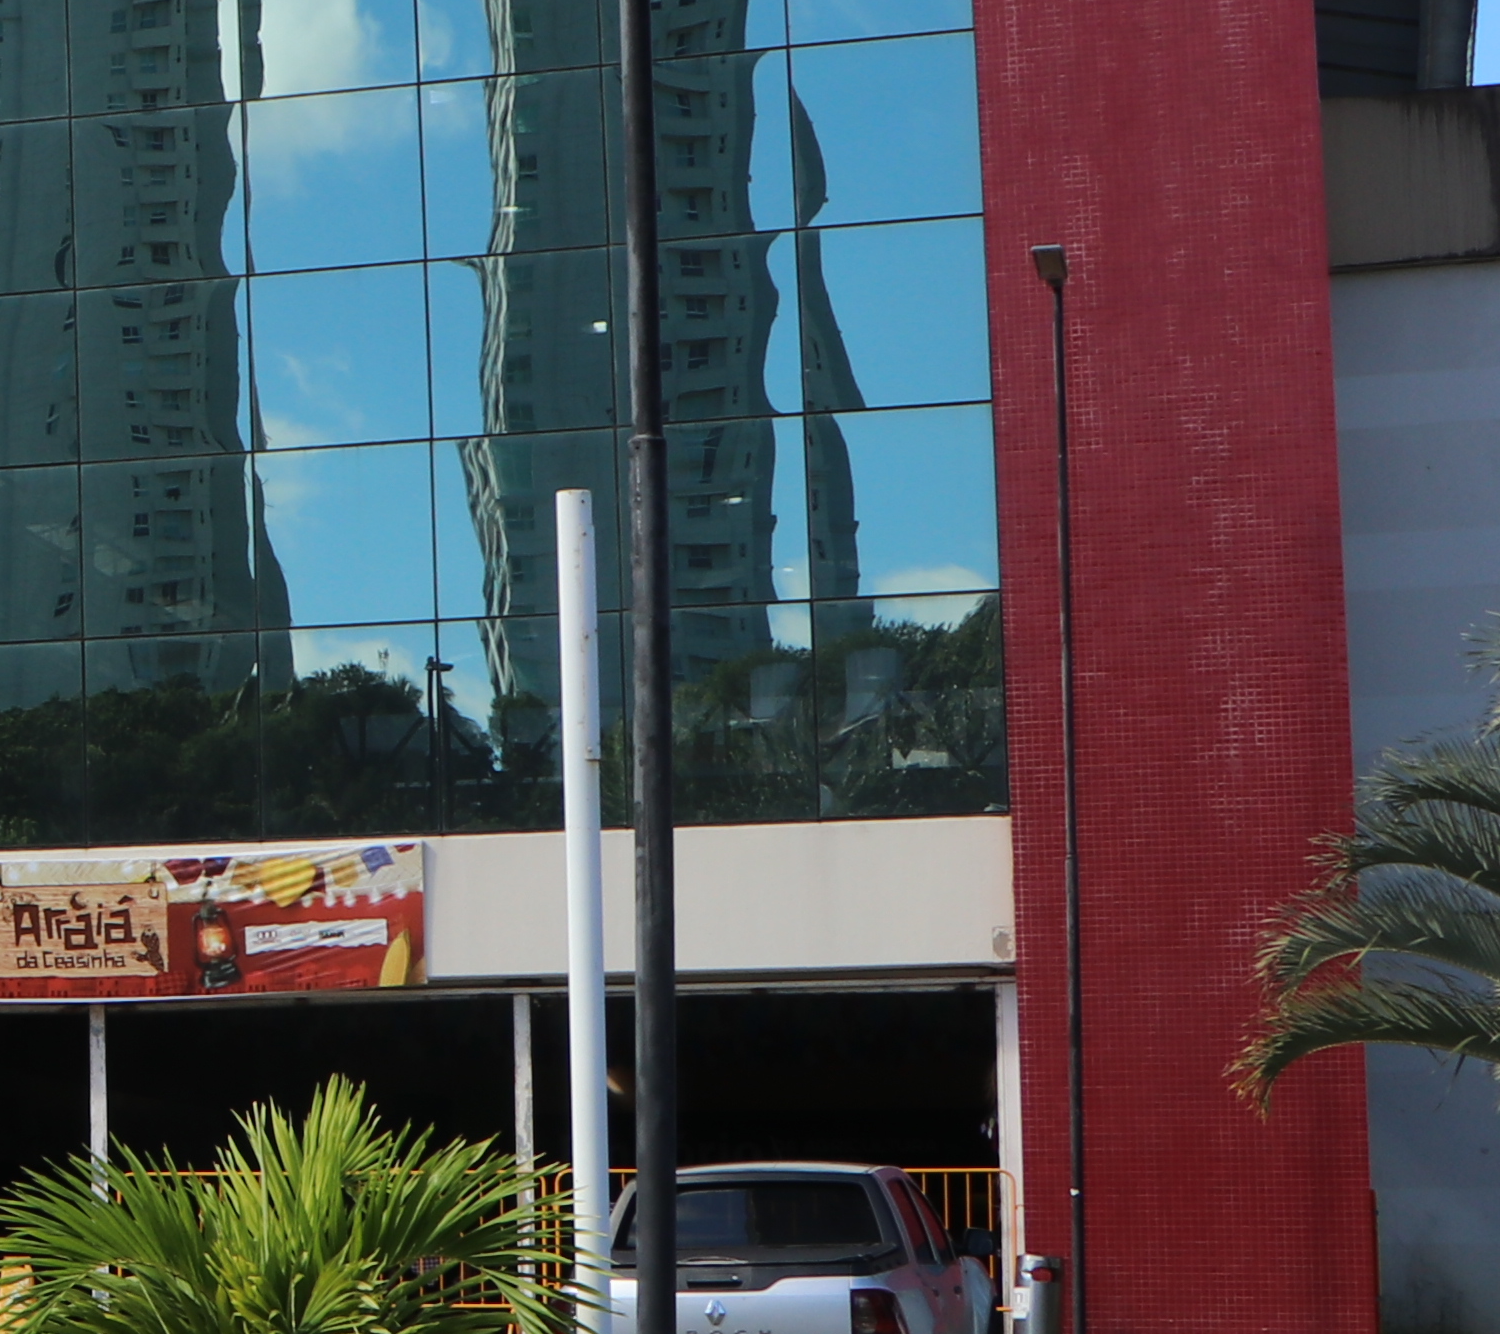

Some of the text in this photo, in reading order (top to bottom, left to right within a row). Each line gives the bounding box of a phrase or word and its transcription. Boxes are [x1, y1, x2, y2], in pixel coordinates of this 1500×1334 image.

[13, 895, 137, 951] Arraiá
[16, 949, 126, 969] da Ceasinha
